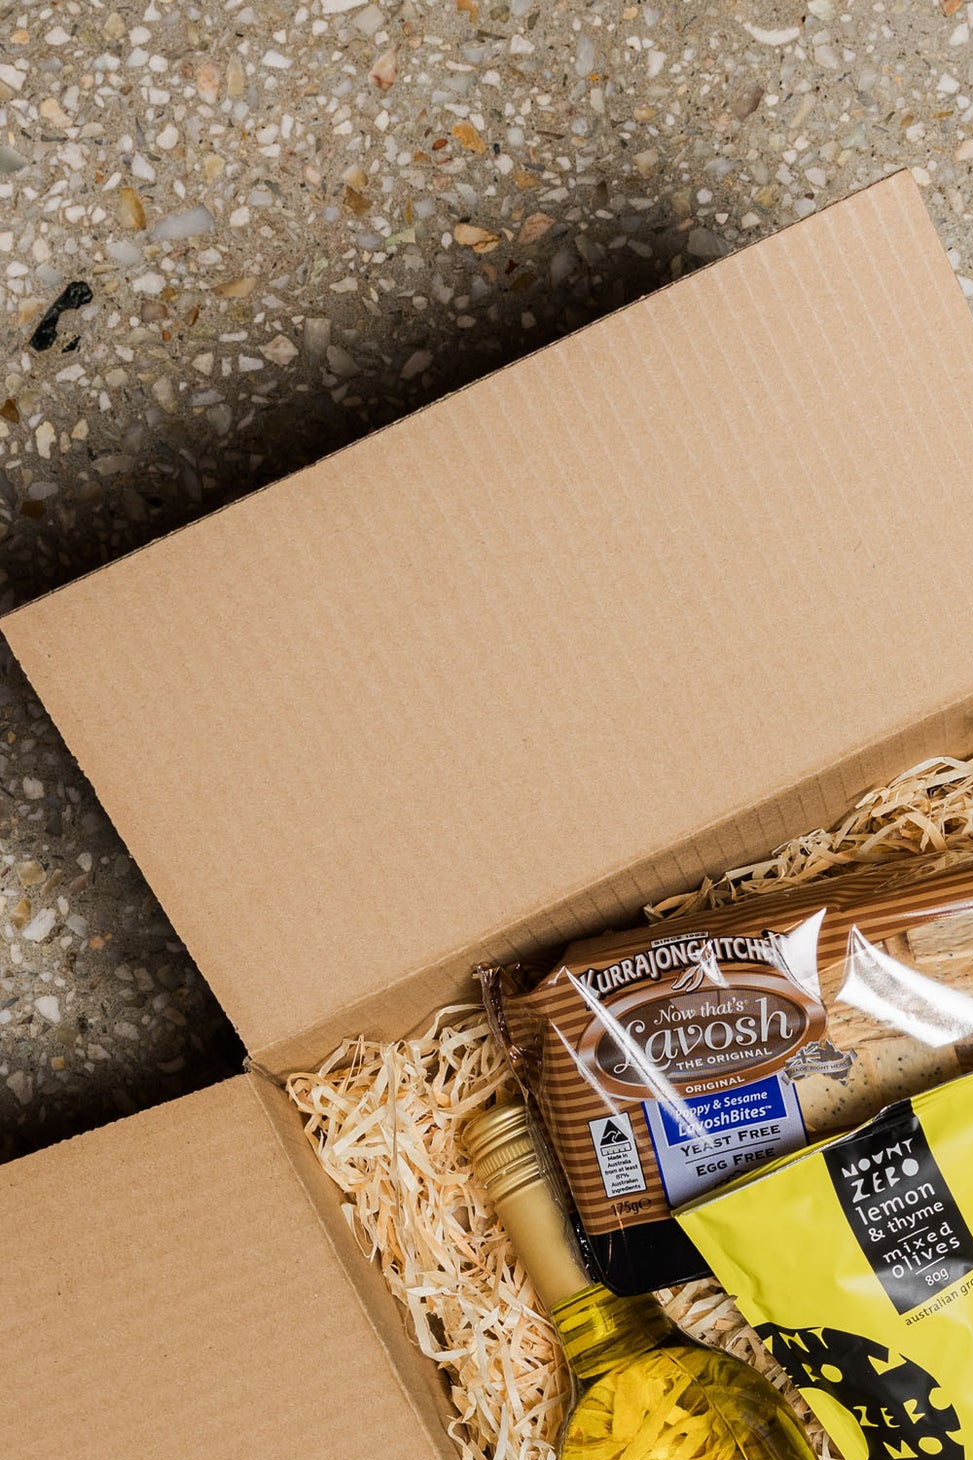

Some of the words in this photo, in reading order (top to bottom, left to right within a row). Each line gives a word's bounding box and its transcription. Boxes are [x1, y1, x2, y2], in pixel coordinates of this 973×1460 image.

[577, 942, 702, 999] KURRAJONG
[654, 1005, 696, 1026] Now
[700, 997, 744, 1017] that's
[613, 997, 794, 1074] Lavosh
[676, 1058, 704, 1071] THE
[707, 1047, 773, 1065] ORIGINAL
[685, 1076, 745, 1094] ORIGINAL
[713, 1099, 722, 1110] &
[724, 1091, 768, 1108] Sesame
[680, 1135, 731, 1158] YEAST
[738, 1124, 781, 1142] FREE
[841, 1138, 914, 1178] MOUNT
[607, 1160, 632, 1168] Australia
[696, 1160, 727, 1177] EGG
[733, 1148, 775, 1166] FREE
[850, 1158, 920, 1203] ZERO
[612, 1177, 639, 1187] Australian
[855, 1182, 936, 1226] lemon
[868, 1228, 886, 1242] &
[887, 1201, 945, 1234] thyme
[882, 1221, 954, 1263] mixed
[892, 1237, 961, 1279] olives
[925, 1267, 949, 1287] 80g
[905, 1289, 959, 1327] australian
